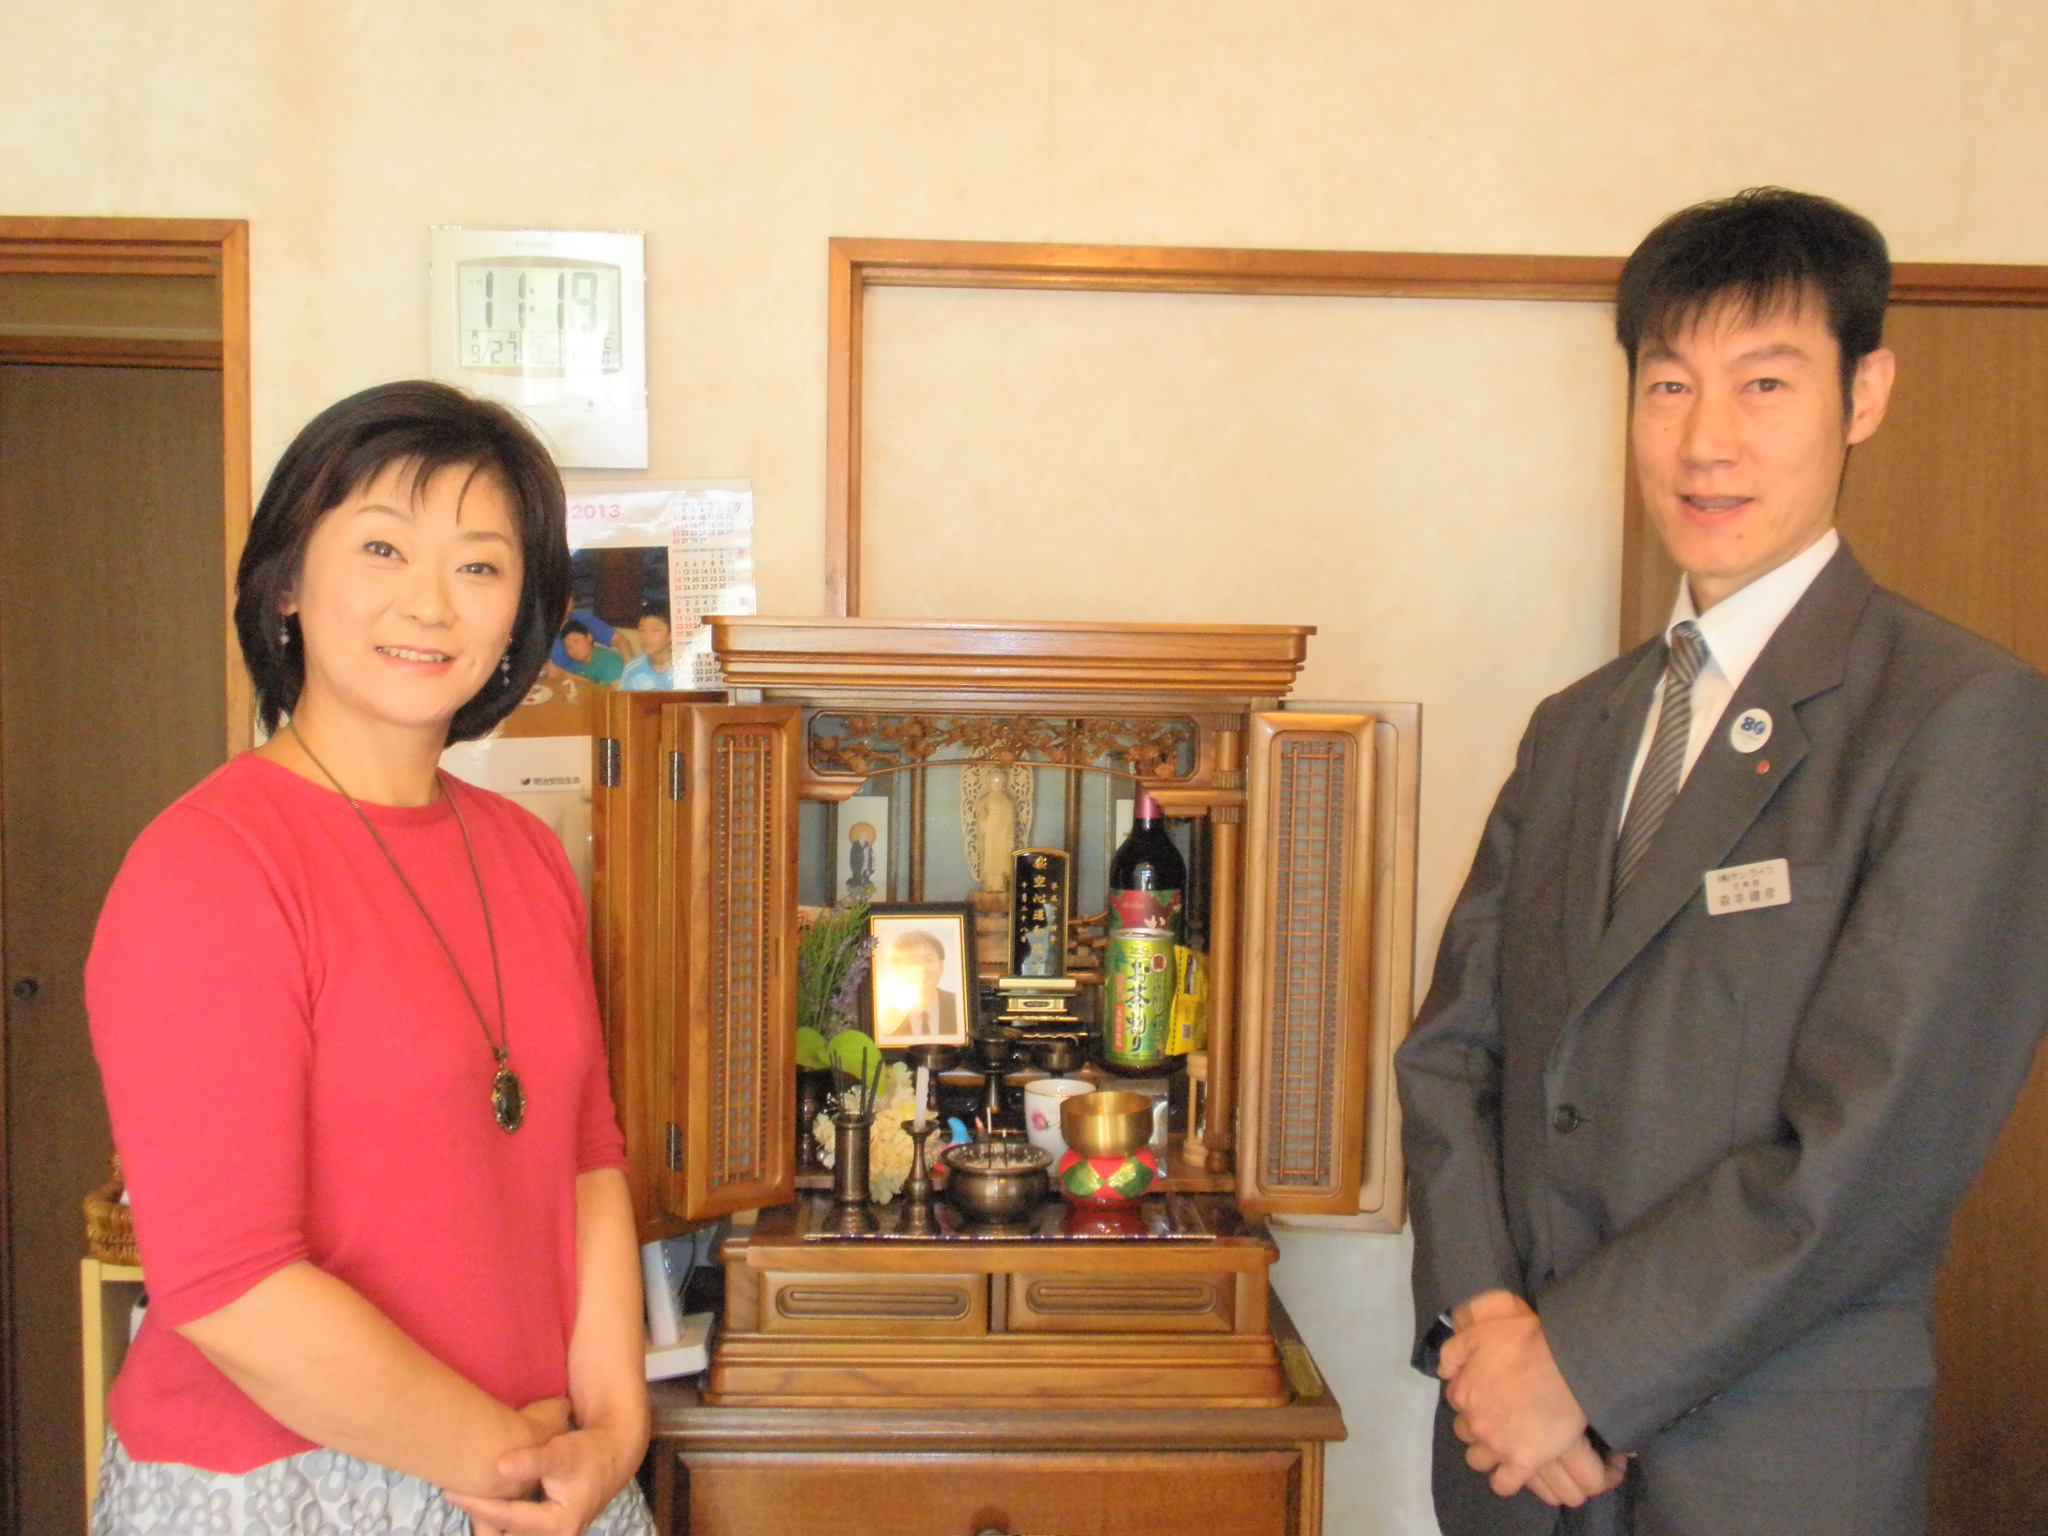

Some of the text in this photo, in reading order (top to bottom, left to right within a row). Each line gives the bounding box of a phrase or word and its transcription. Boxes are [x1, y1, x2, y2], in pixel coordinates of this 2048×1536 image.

[486, 271, 598, 333] 11:19
[572, 504, 620, 519] 2013
[737, 549, 745, 559] 8
